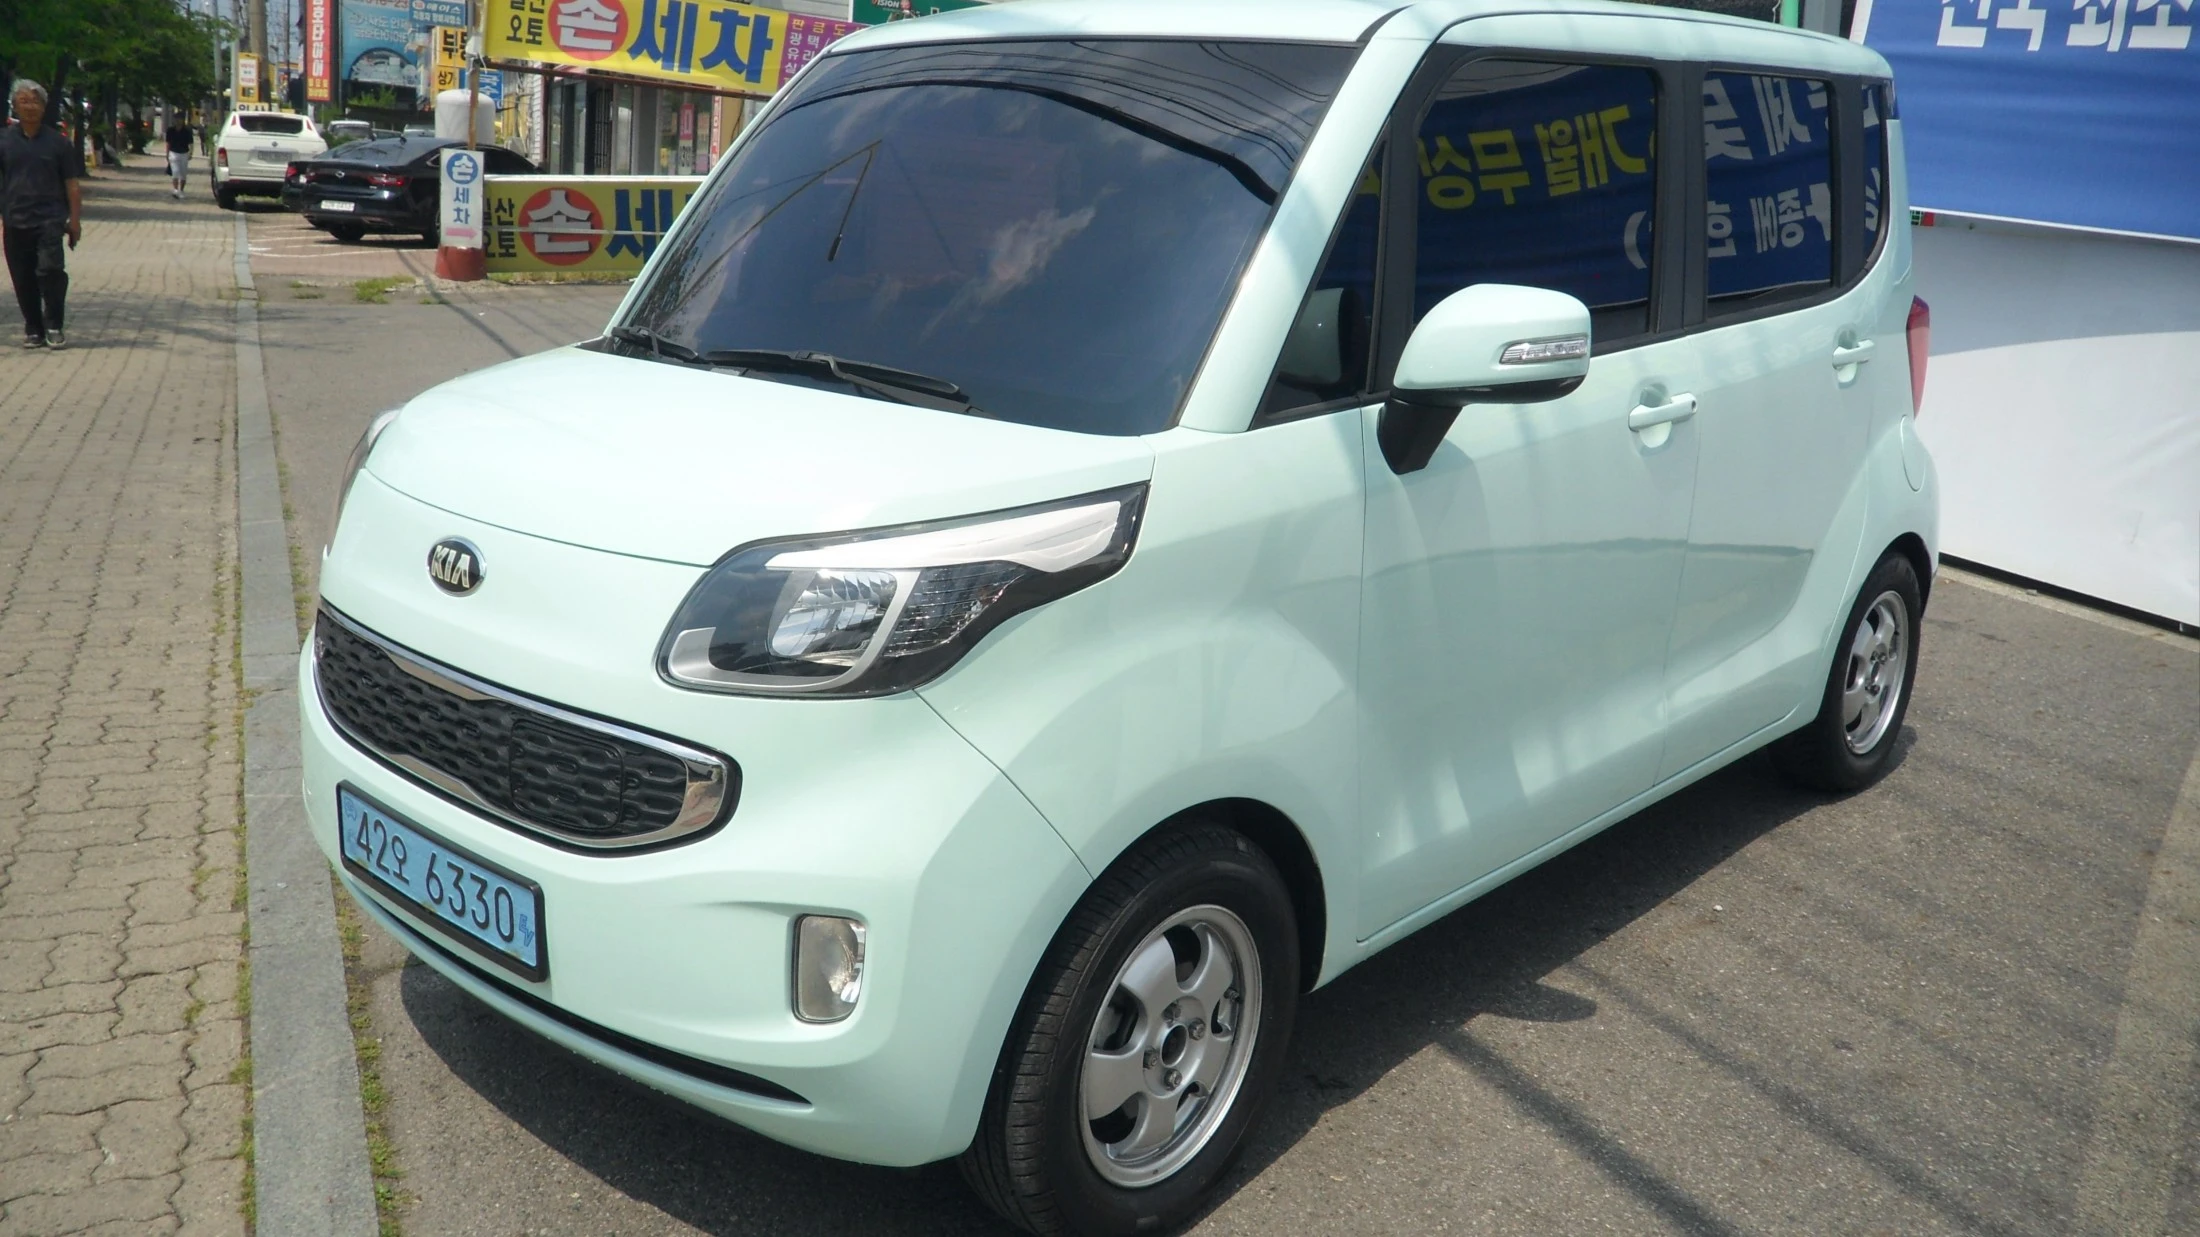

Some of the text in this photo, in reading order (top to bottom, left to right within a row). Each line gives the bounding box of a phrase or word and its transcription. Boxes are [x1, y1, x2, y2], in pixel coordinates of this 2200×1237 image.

[506, 15, 543, 45] 오토
[626, 0, 774, 84] 세차
[604, 188, 692, 264] 세
[431, 544, 471, 588] KIA
[356, 811, 514, 942] 42오 6330
